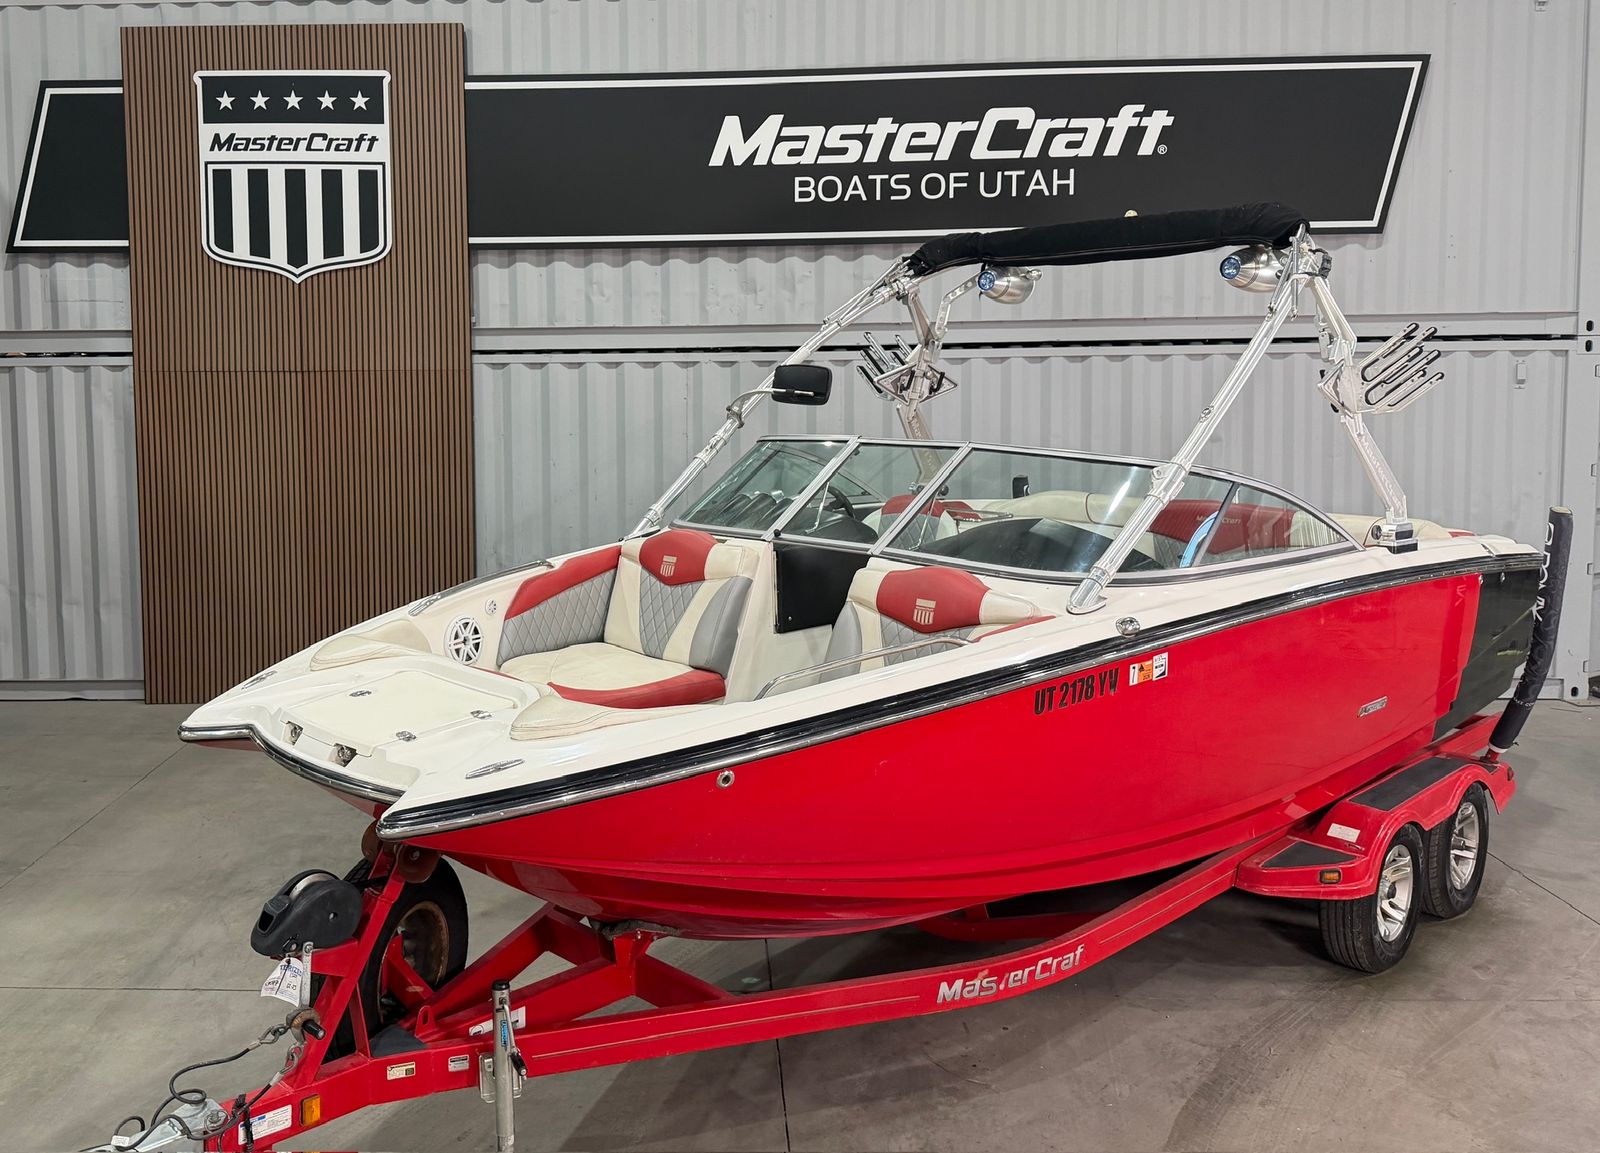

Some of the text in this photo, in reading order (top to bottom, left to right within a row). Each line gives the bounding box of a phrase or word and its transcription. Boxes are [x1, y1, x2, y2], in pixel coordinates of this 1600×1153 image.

[209, 132, 379, 152] MasterCraft
[794, 168, 1075, 203] BOATS OF UTAH
[1034, 686, 1056, 715] UT
[1058, 674, 1095, 709] 2178
